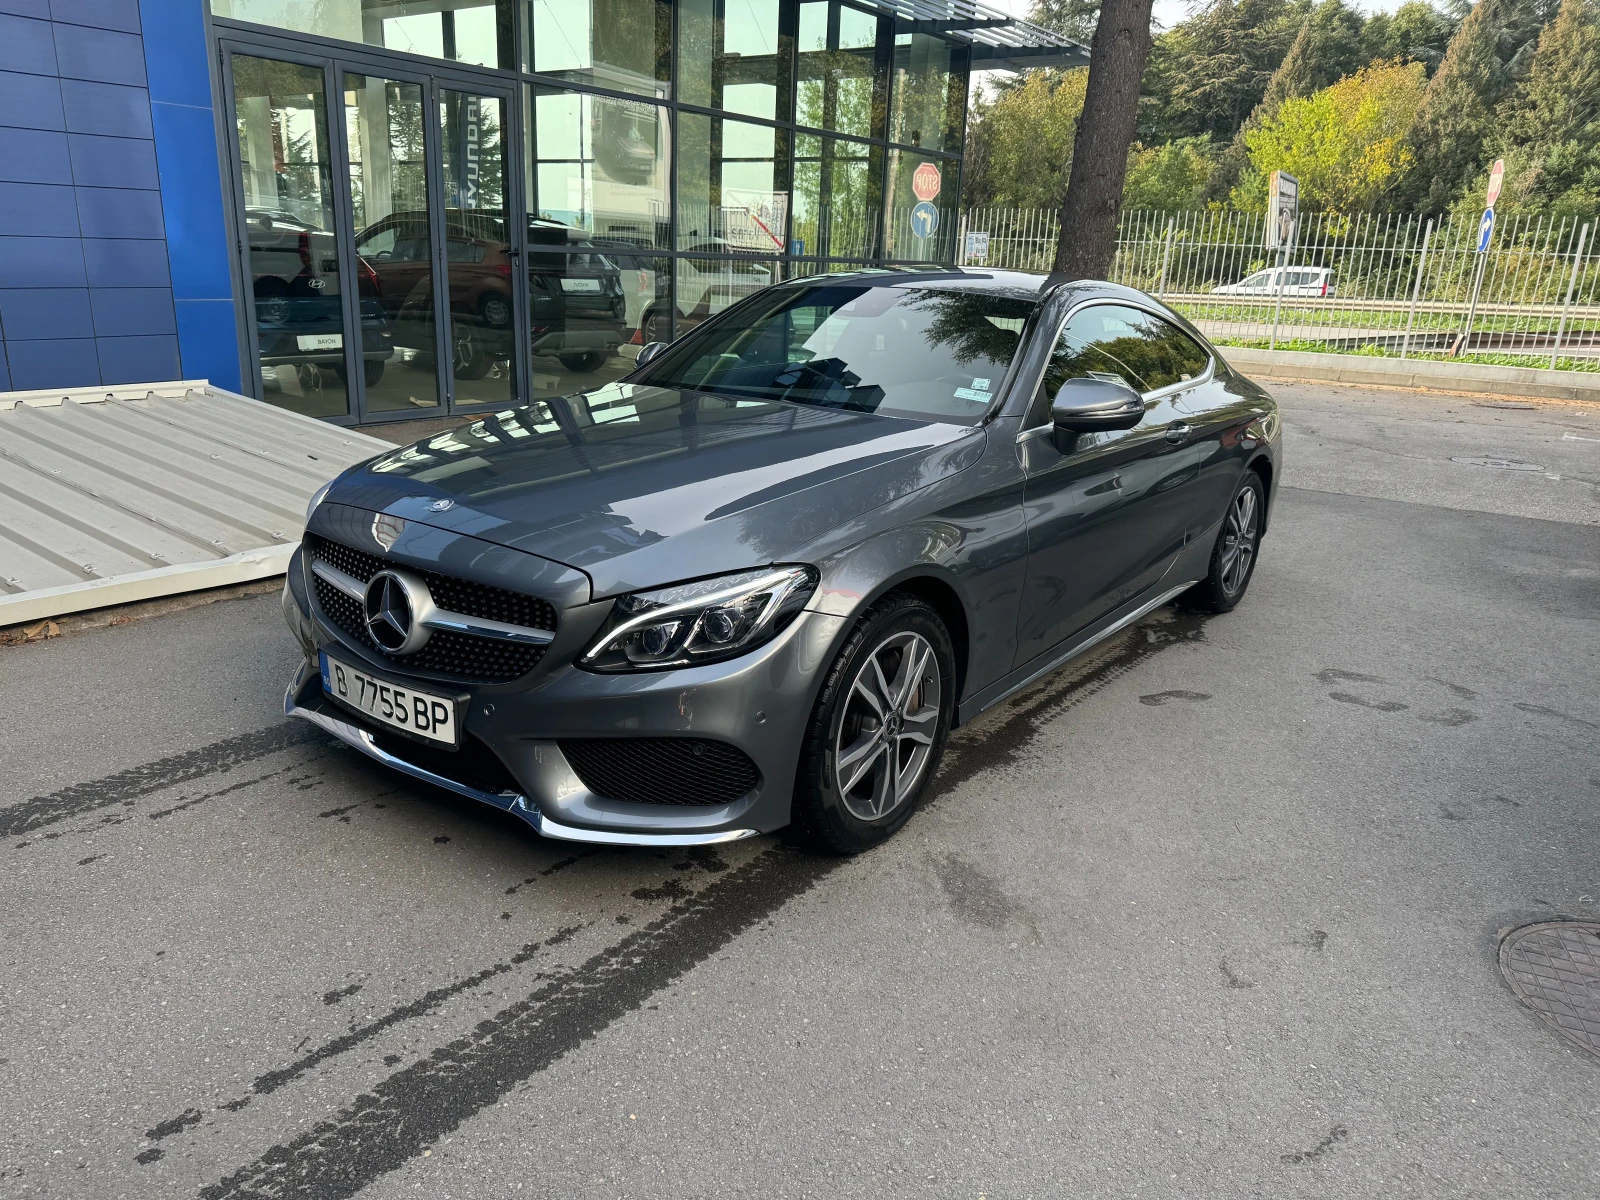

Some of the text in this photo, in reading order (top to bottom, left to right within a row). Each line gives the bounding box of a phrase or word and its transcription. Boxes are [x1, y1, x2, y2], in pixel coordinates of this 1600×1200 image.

[335, 663, 348, 697] B
[354, 673, 409, 724] 7755
[413, 696, 449, 734] BP
